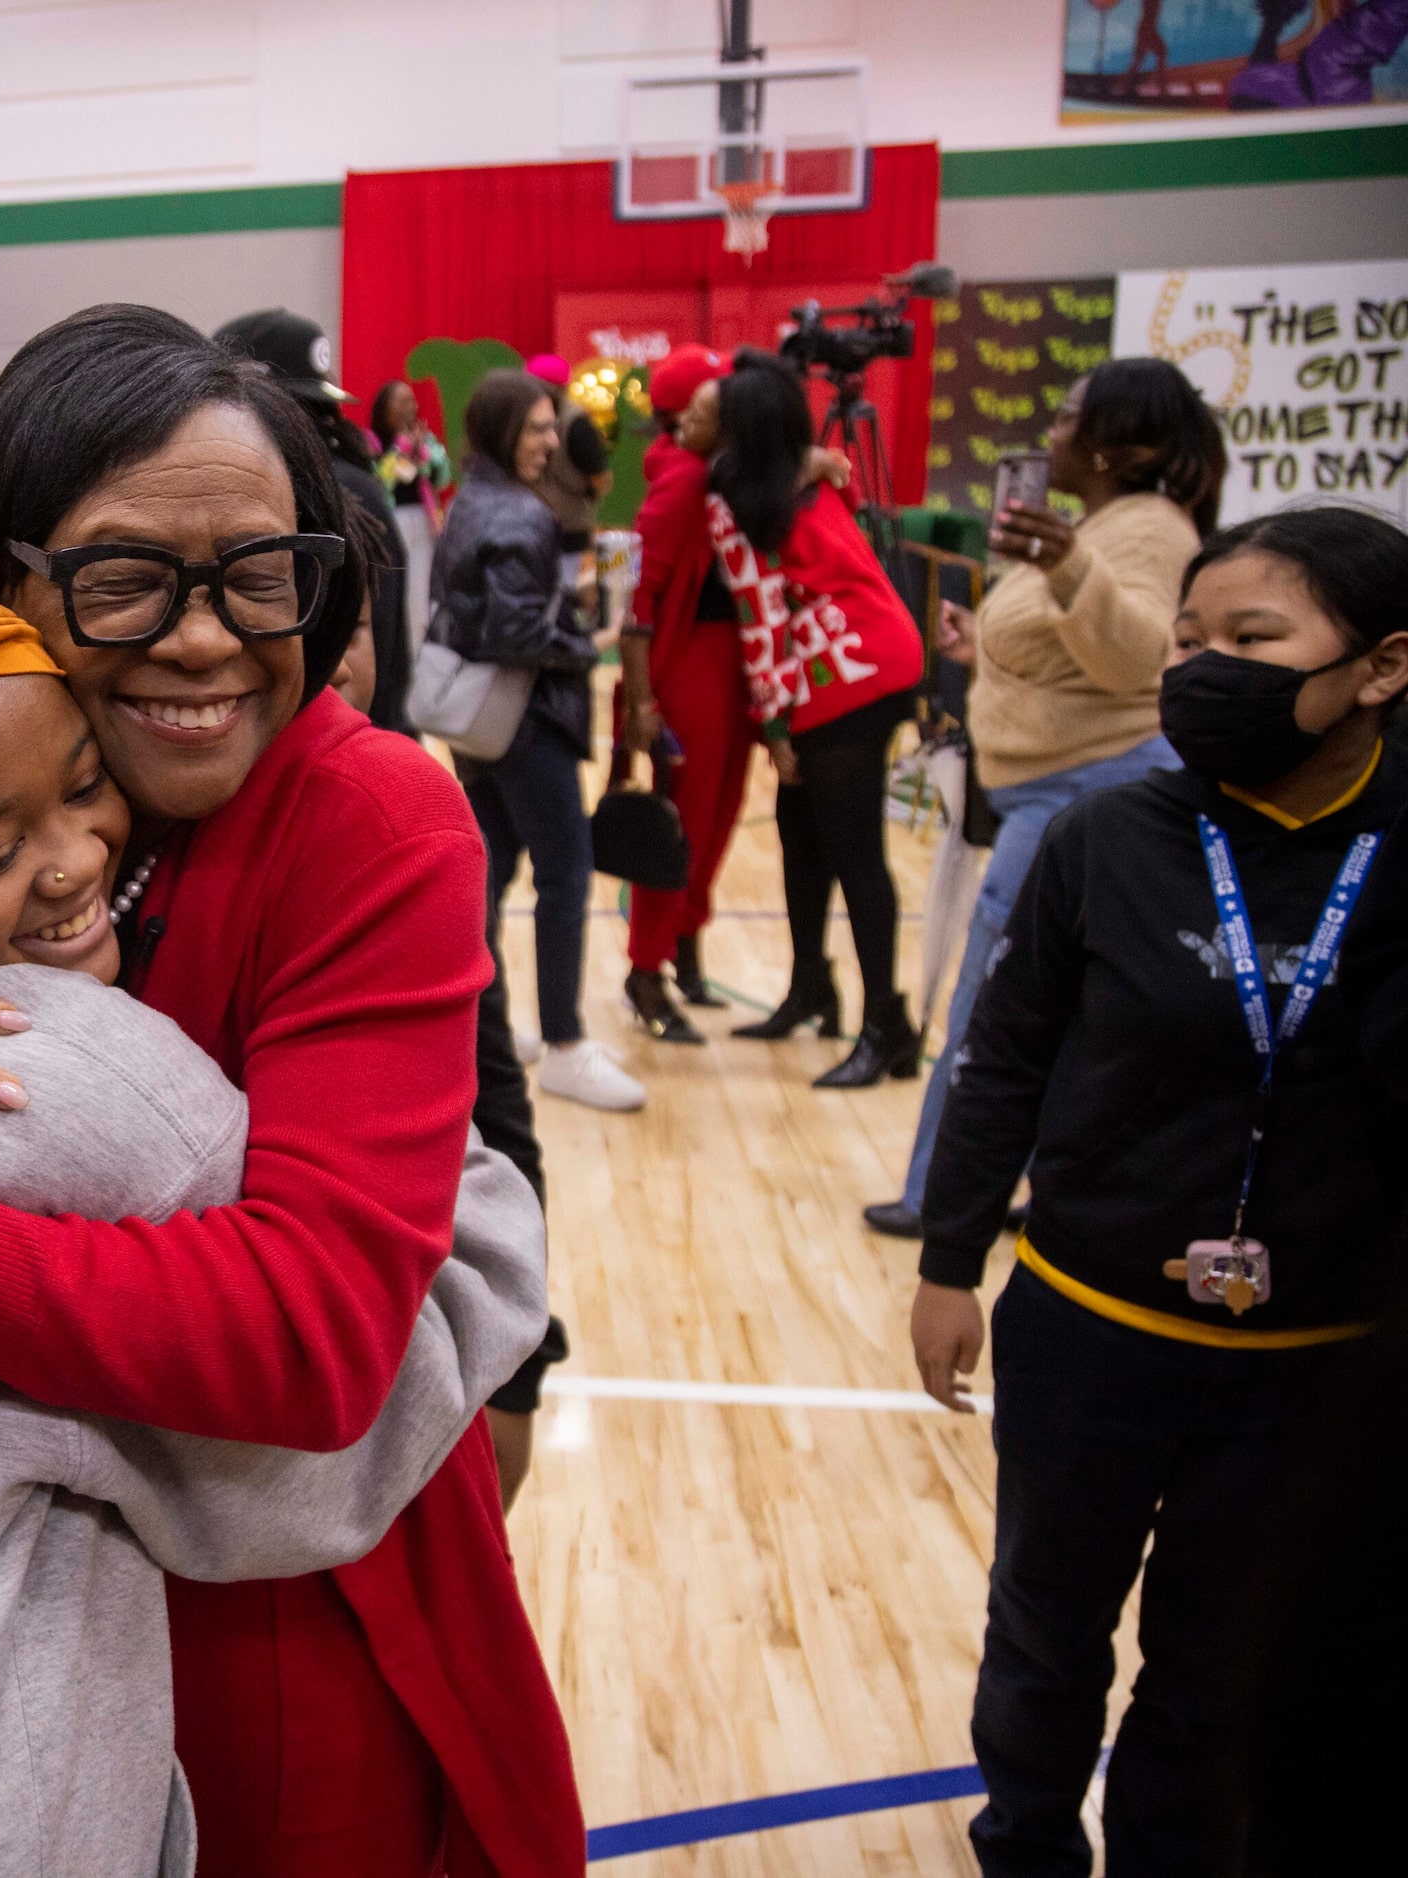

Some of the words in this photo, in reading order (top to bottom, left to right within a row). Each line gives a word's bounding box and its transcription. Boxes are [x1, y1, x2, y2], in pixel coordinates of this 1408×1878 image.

[1296, 350, 1403, 393] GOT
[1218, 402, 1405, 444] OMETH
[1240, 452, 1298, 491] TO
[1314, 450, 1408, 491] SAY
